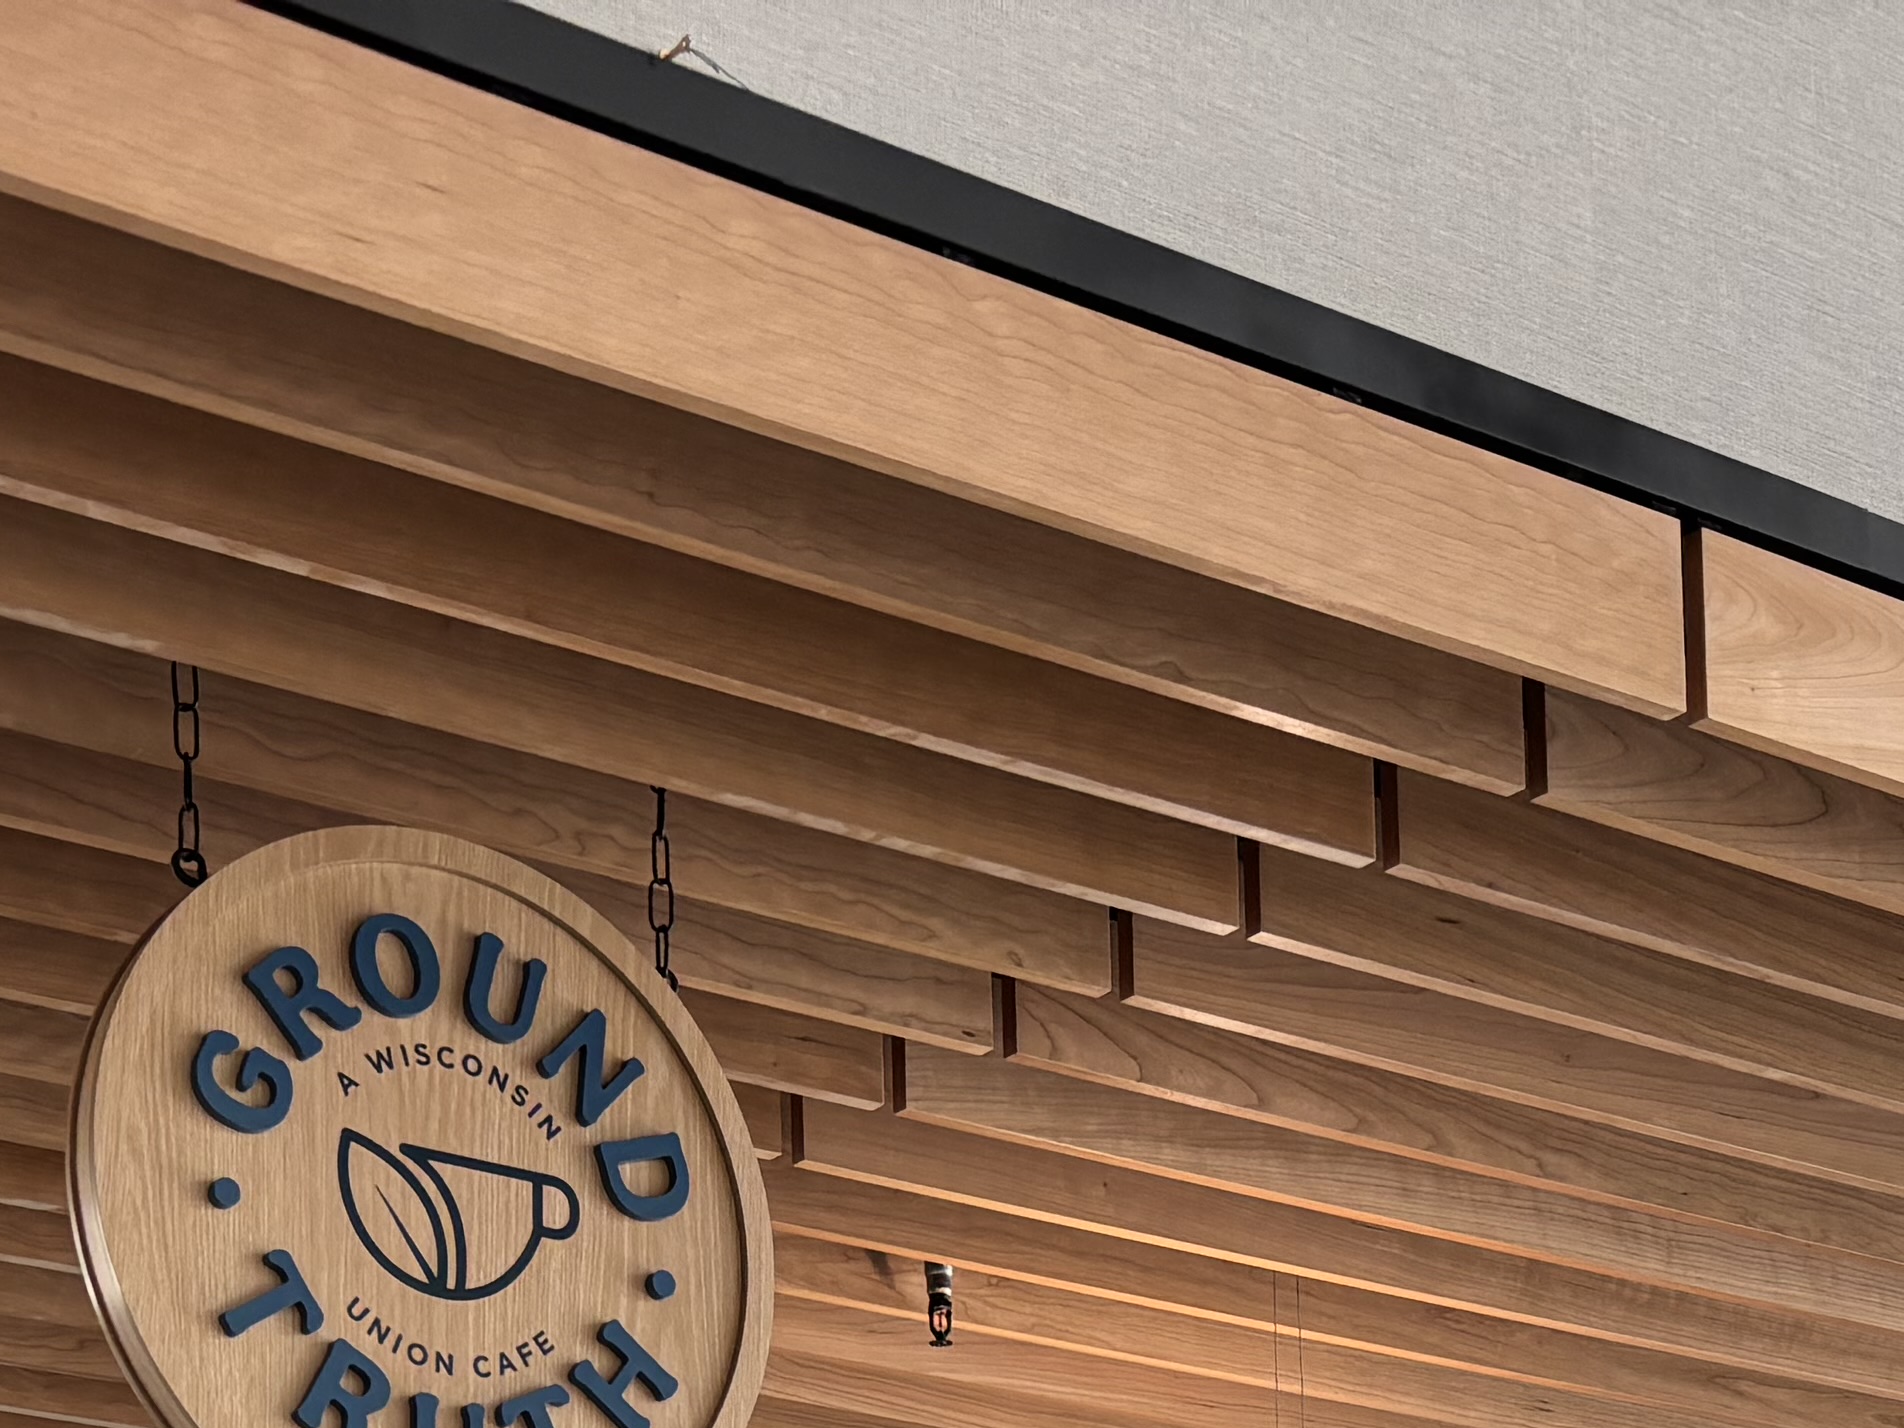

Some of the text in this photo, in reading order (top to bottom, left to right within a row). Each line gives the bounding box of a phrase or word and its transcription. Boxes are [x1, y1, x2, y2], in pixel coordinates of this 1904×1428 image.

[190, 913, 689, 1220] GROUND
[337, 1042, 562, 1142] A WISCONSIN
[347, 1296, 556, 1378] UNION CAFE
